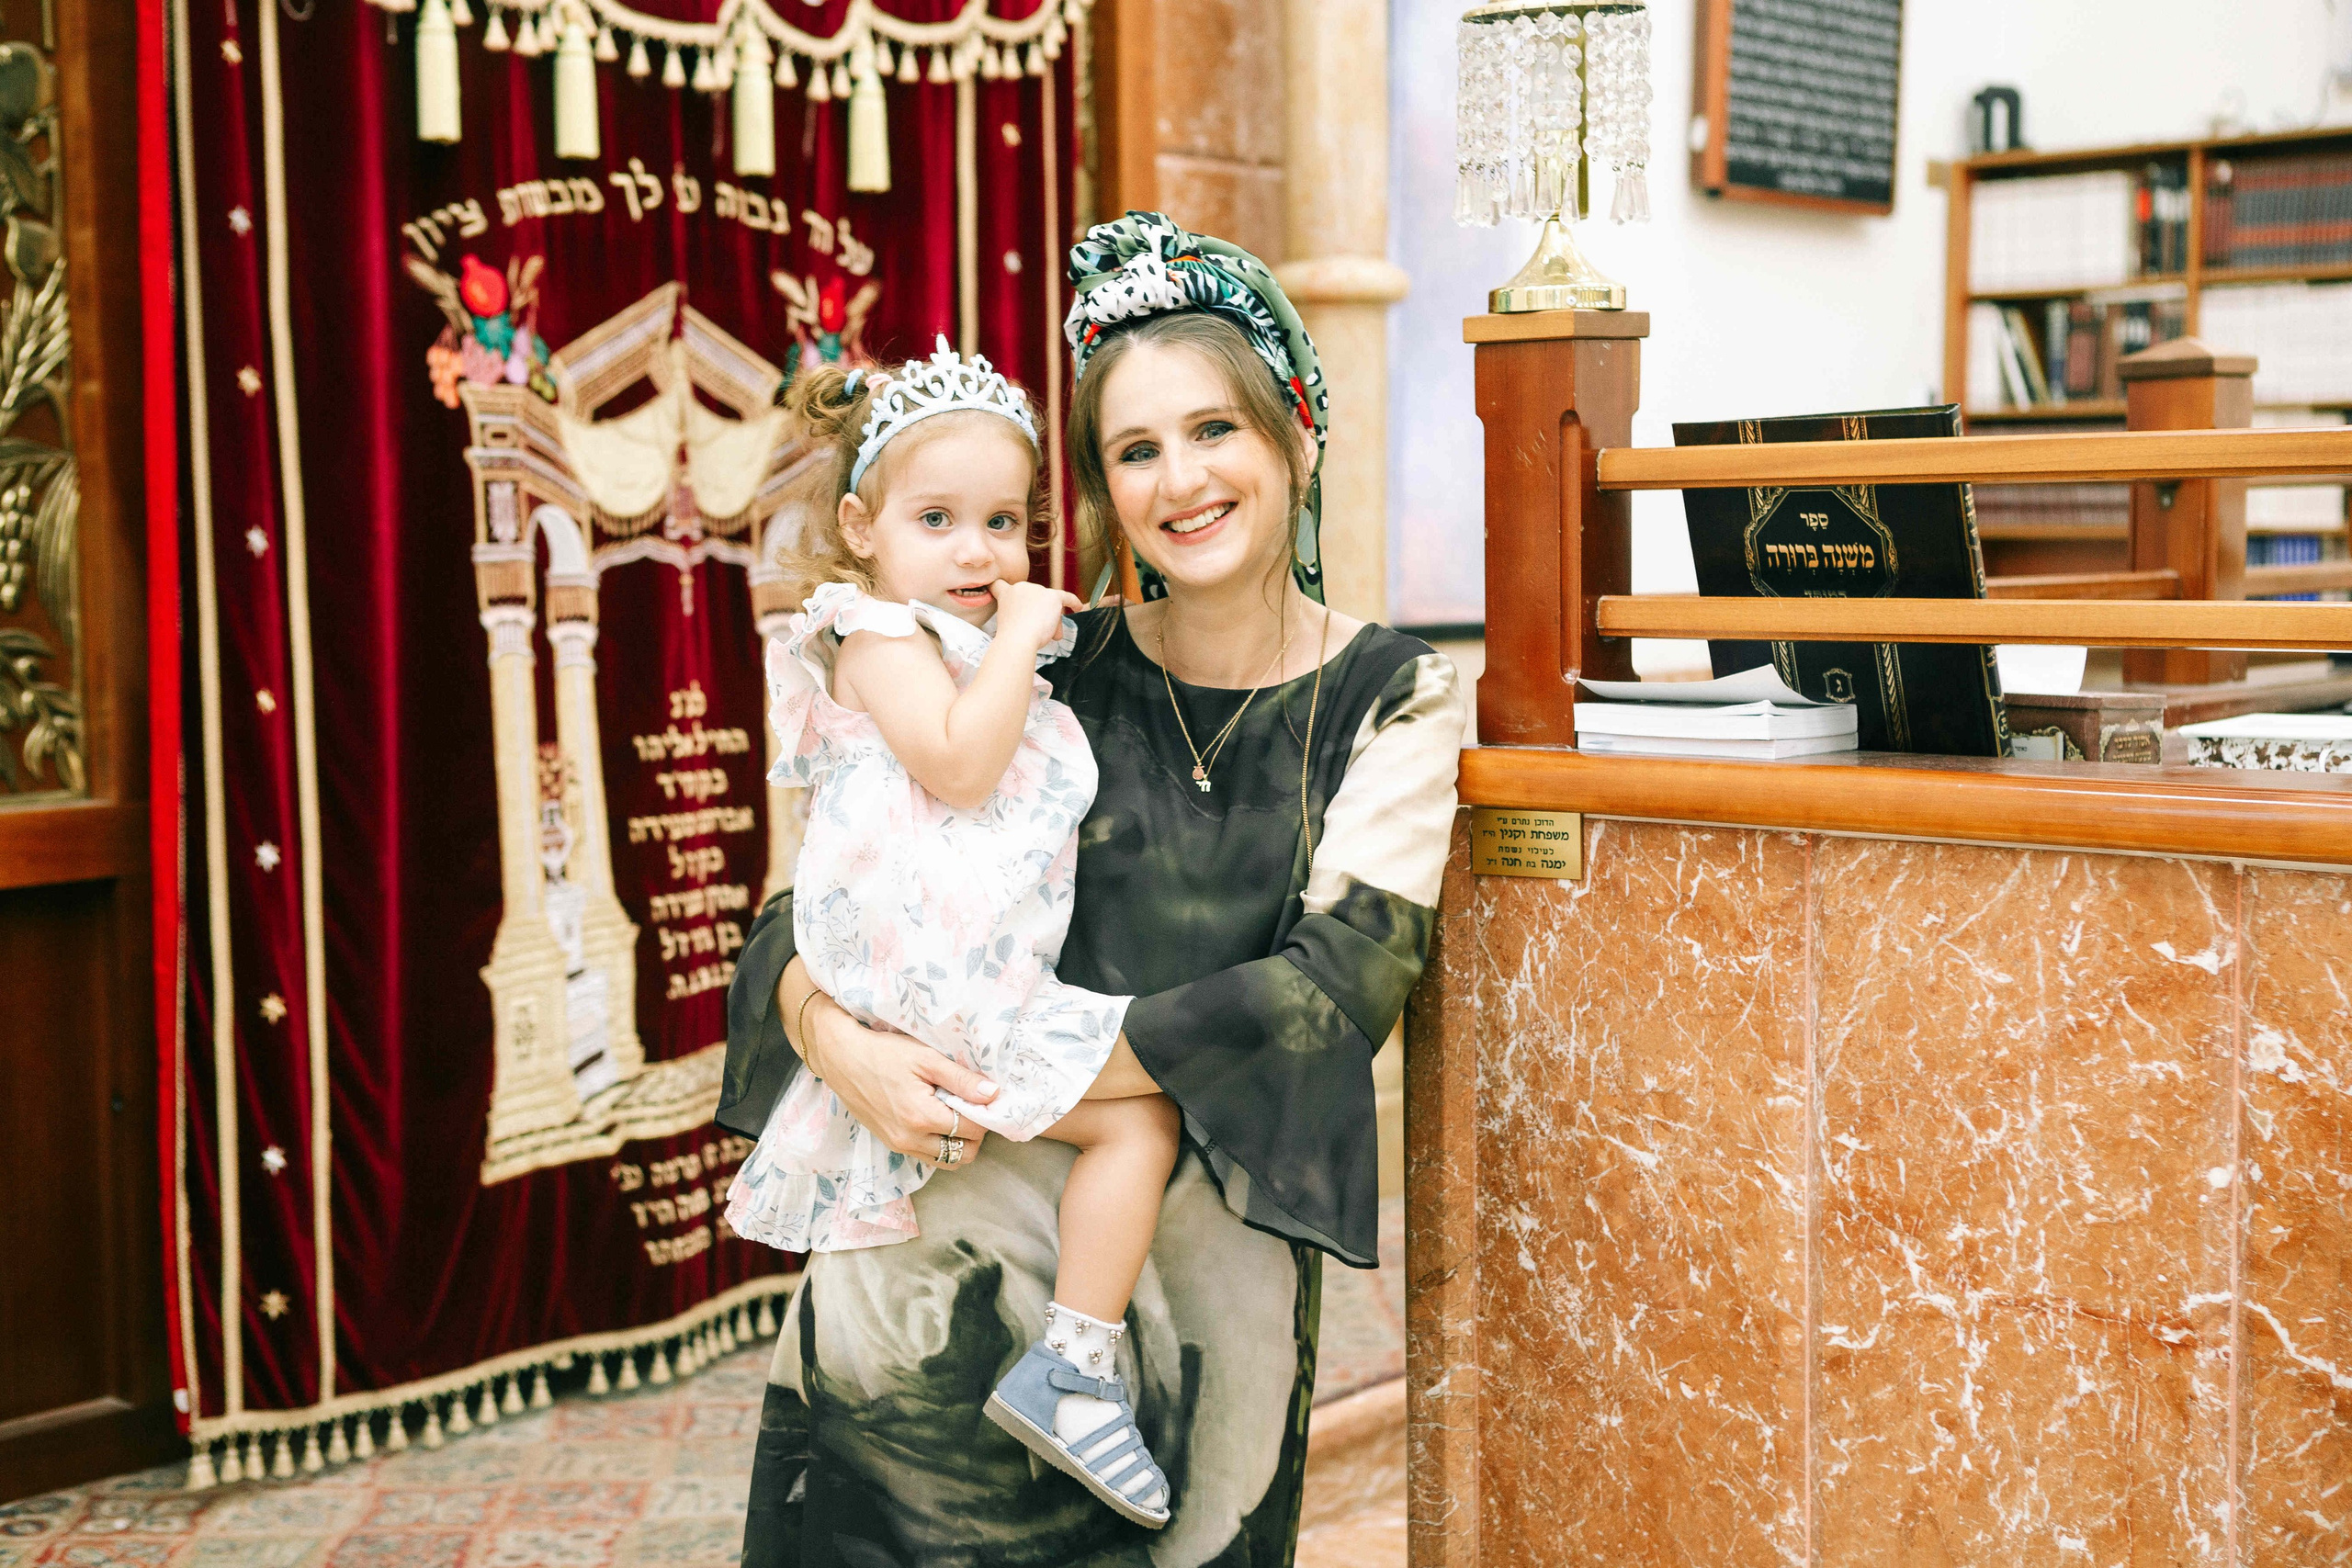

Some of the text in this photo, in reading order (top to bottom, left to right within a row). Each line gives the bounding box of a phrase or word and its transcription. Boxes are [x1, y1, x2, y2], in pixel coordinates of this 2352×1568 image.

[608, 157, 663, 222] לך
[401, 197, 488, 263] ציון
[1499, 829, 1526, 840] וקנין
[1530, 829, 1569, 840] משפחת
[1501, 857, 1521, 867] חנה
[1541, 859, 1566, 869] ימנה
